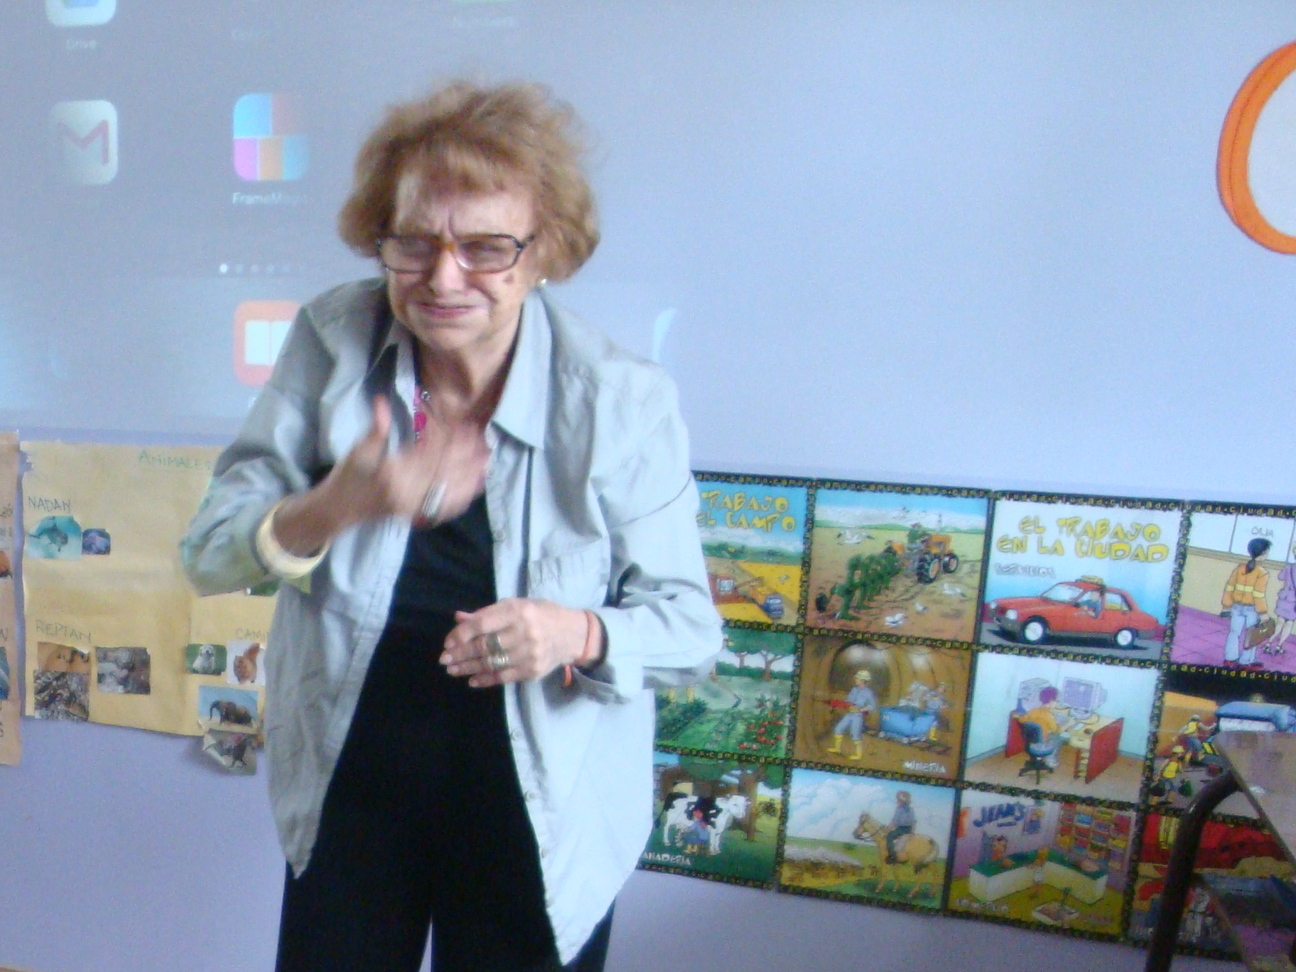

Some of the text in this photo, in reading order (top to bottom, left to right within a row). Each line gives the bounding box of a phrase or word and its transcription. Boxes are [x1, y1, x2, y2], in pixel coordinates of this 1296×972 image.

[27, 496, 71, 514] NADAN
[726, 511, 796, 532] CAMPO
[1019, 515, 1161, 542] EL TRABAJO
[996, 534, 1170, 563] EN LA CIUDAD
[35, 619, 92, 643] REPTAN
